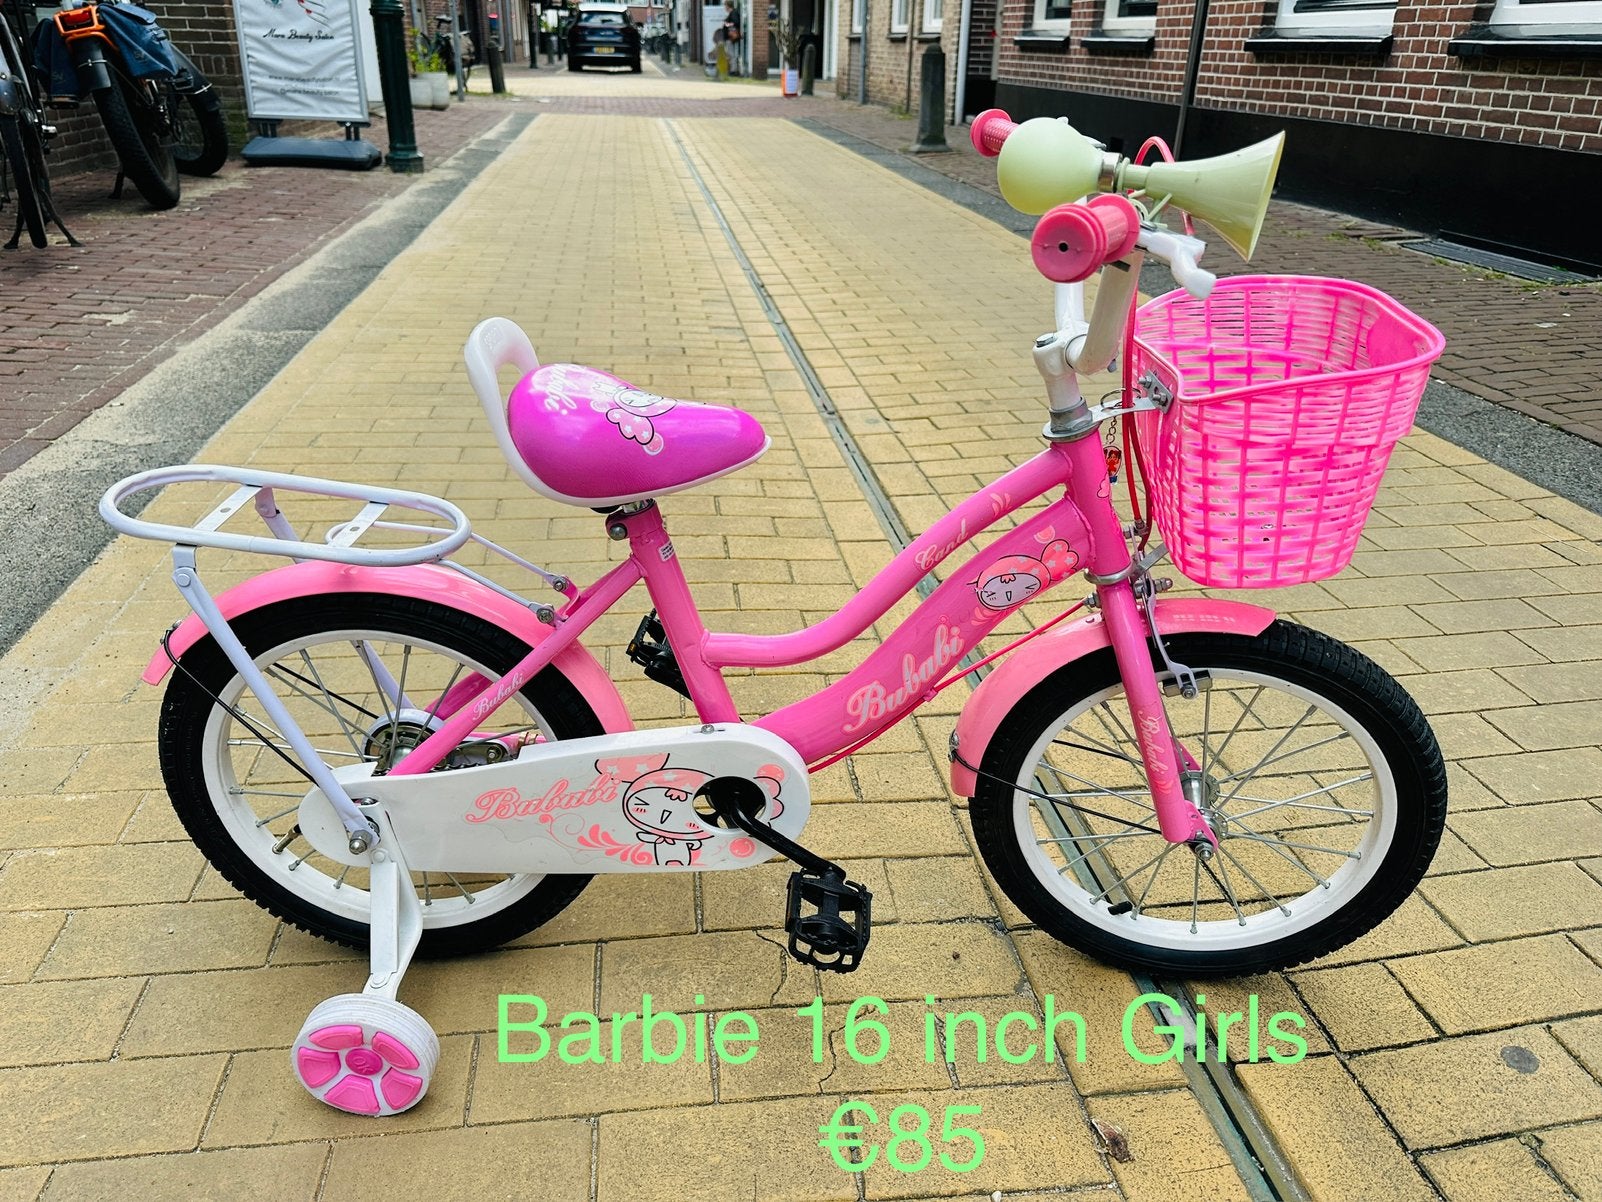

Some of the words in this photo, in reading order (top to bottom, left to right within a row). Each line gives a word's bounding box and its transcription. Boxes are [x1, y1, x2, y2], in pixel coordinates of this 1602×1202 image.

[288, 29, 313, 42] Beauty
[315, 30, 334, 40] Salon
[472, 672, 524, 721] Bubabi
[845, 622, 964, 732] Bubabi
[465, 775, 622, 824] Bubabi
